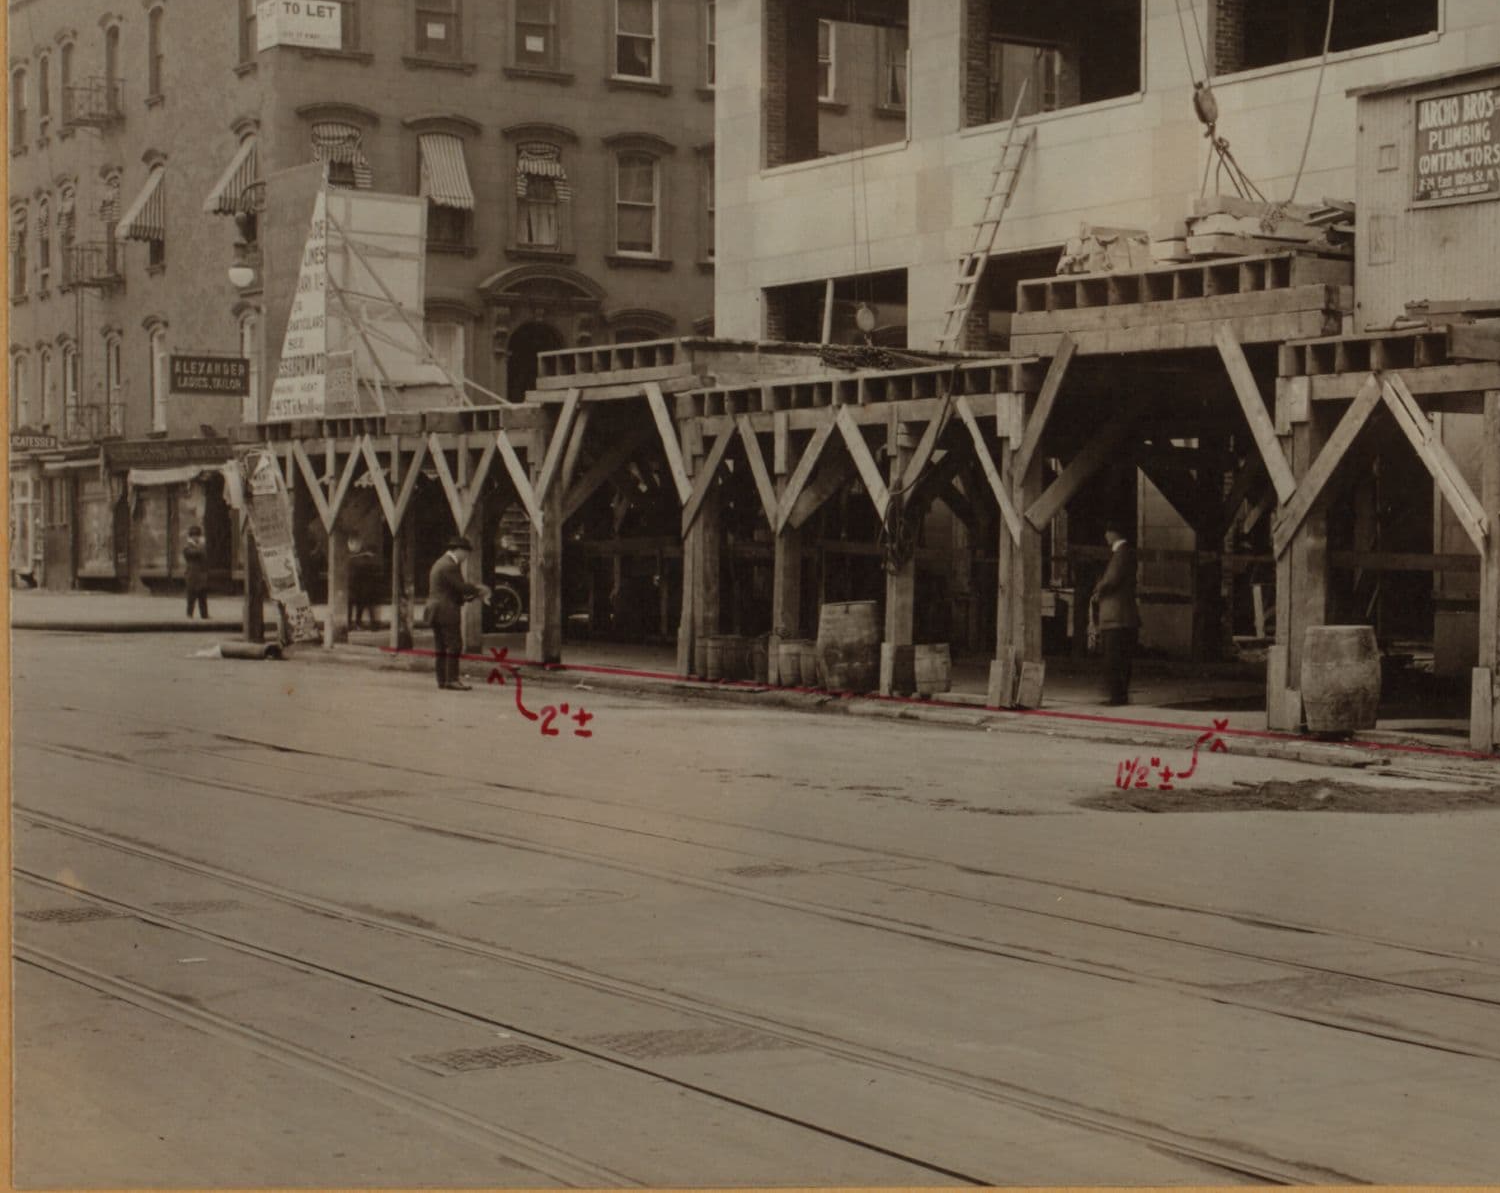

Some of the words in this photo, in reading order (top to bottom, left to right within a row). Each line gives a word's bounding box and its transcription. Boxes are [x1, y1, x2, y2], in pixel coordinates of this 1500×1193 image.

[282, 1, 300, 15] TO
[306, 3, 336, 19] LET
[1429, 121, 1492, 151] PLUMBING
